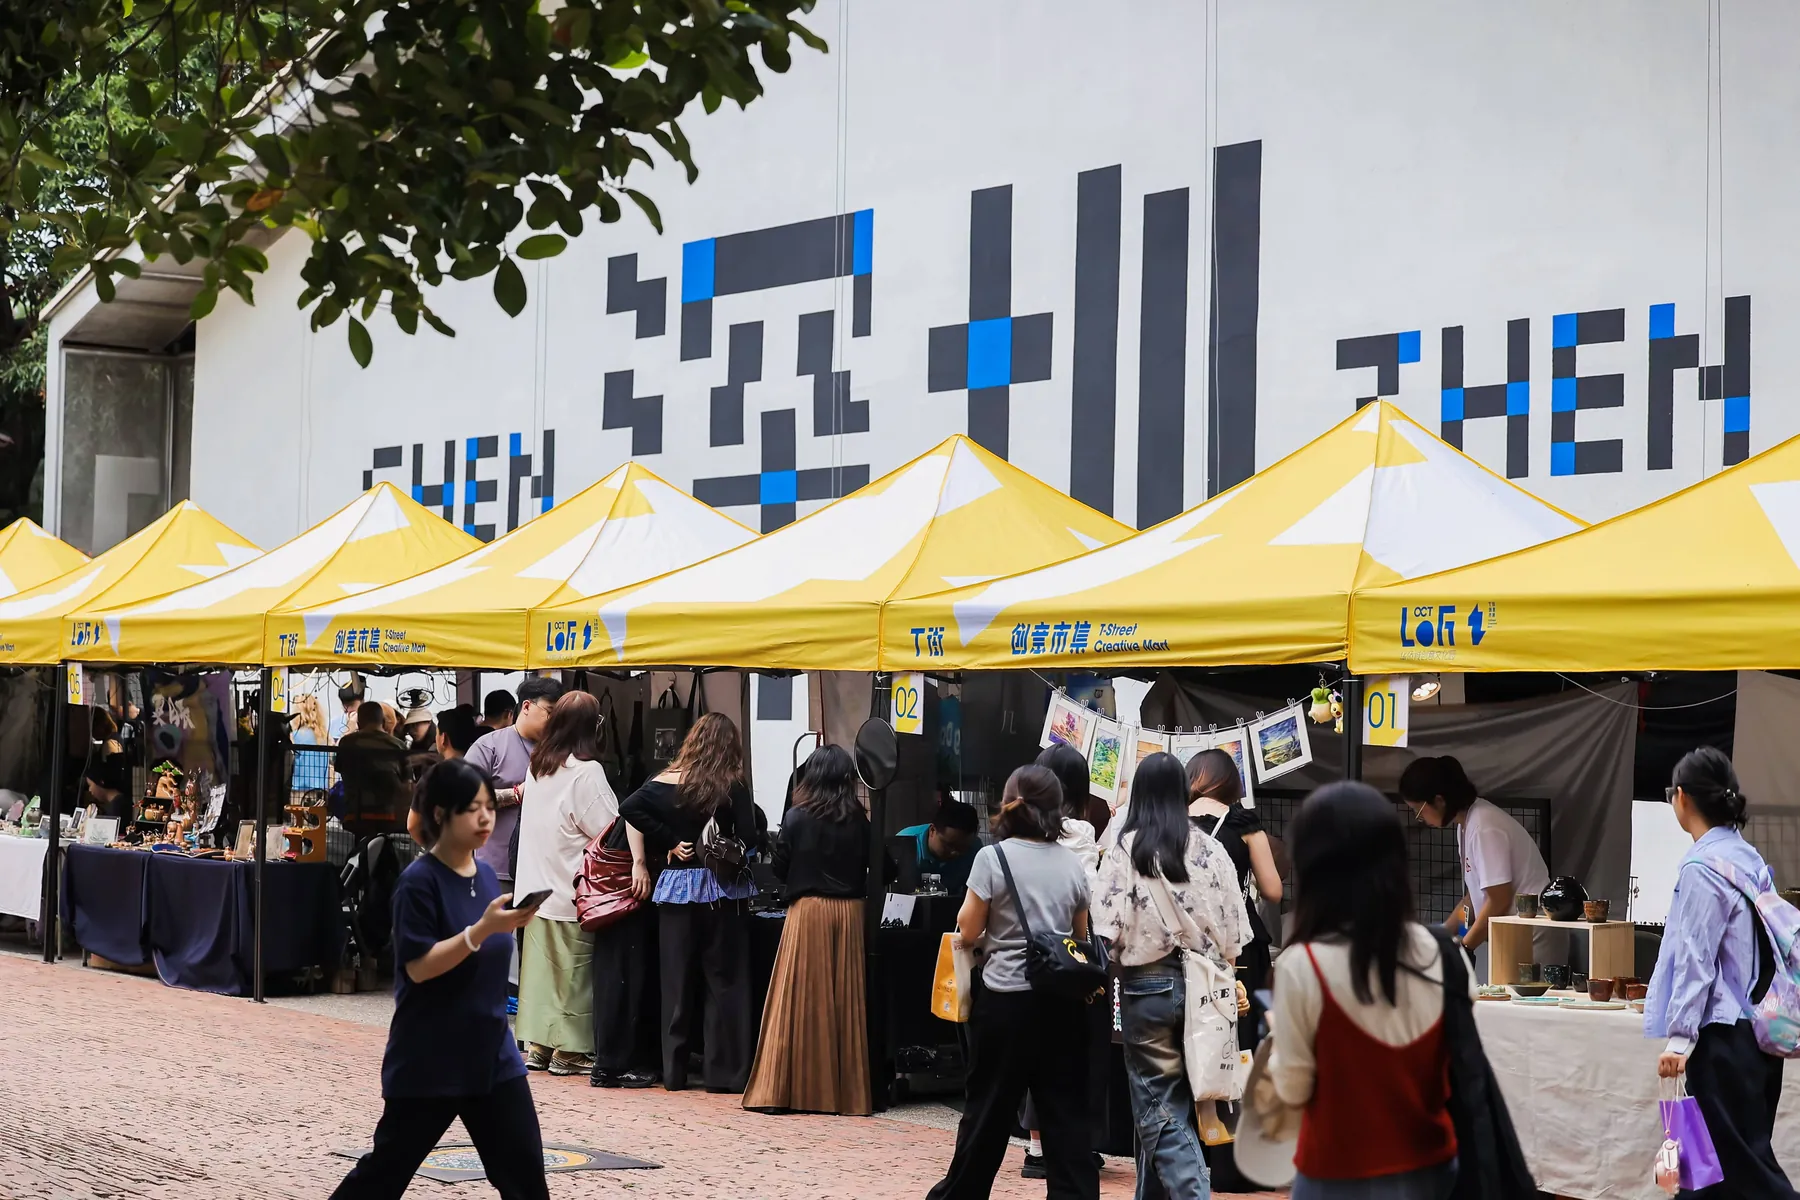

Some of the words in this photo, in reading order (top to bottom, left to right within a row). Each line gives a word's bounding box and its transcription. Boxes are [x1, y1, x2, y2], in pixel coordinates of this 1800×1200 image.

[1414, 606, 1433, 617] OCT
[334, 627, 380, 654] 创意市集
[385, 629, 406, 640] T-Street
[910, 627, 945, 656] T街
[1011, 620, 1091, 655] 创意市集
[1099, 623, 1138, 637] T-Street
[383, 642, 409, 653] Creative
[411, 642, 426, 653] Mart
[1094, 640, 1140, 652] Creative
[1142, 640, 1171, 652] Mart
[69, 671, 80, 695] 05
[273, 677, 285, 701] 04
[895, 687, 918, 720] 02
[1368, 691, 1396, 729] 01
